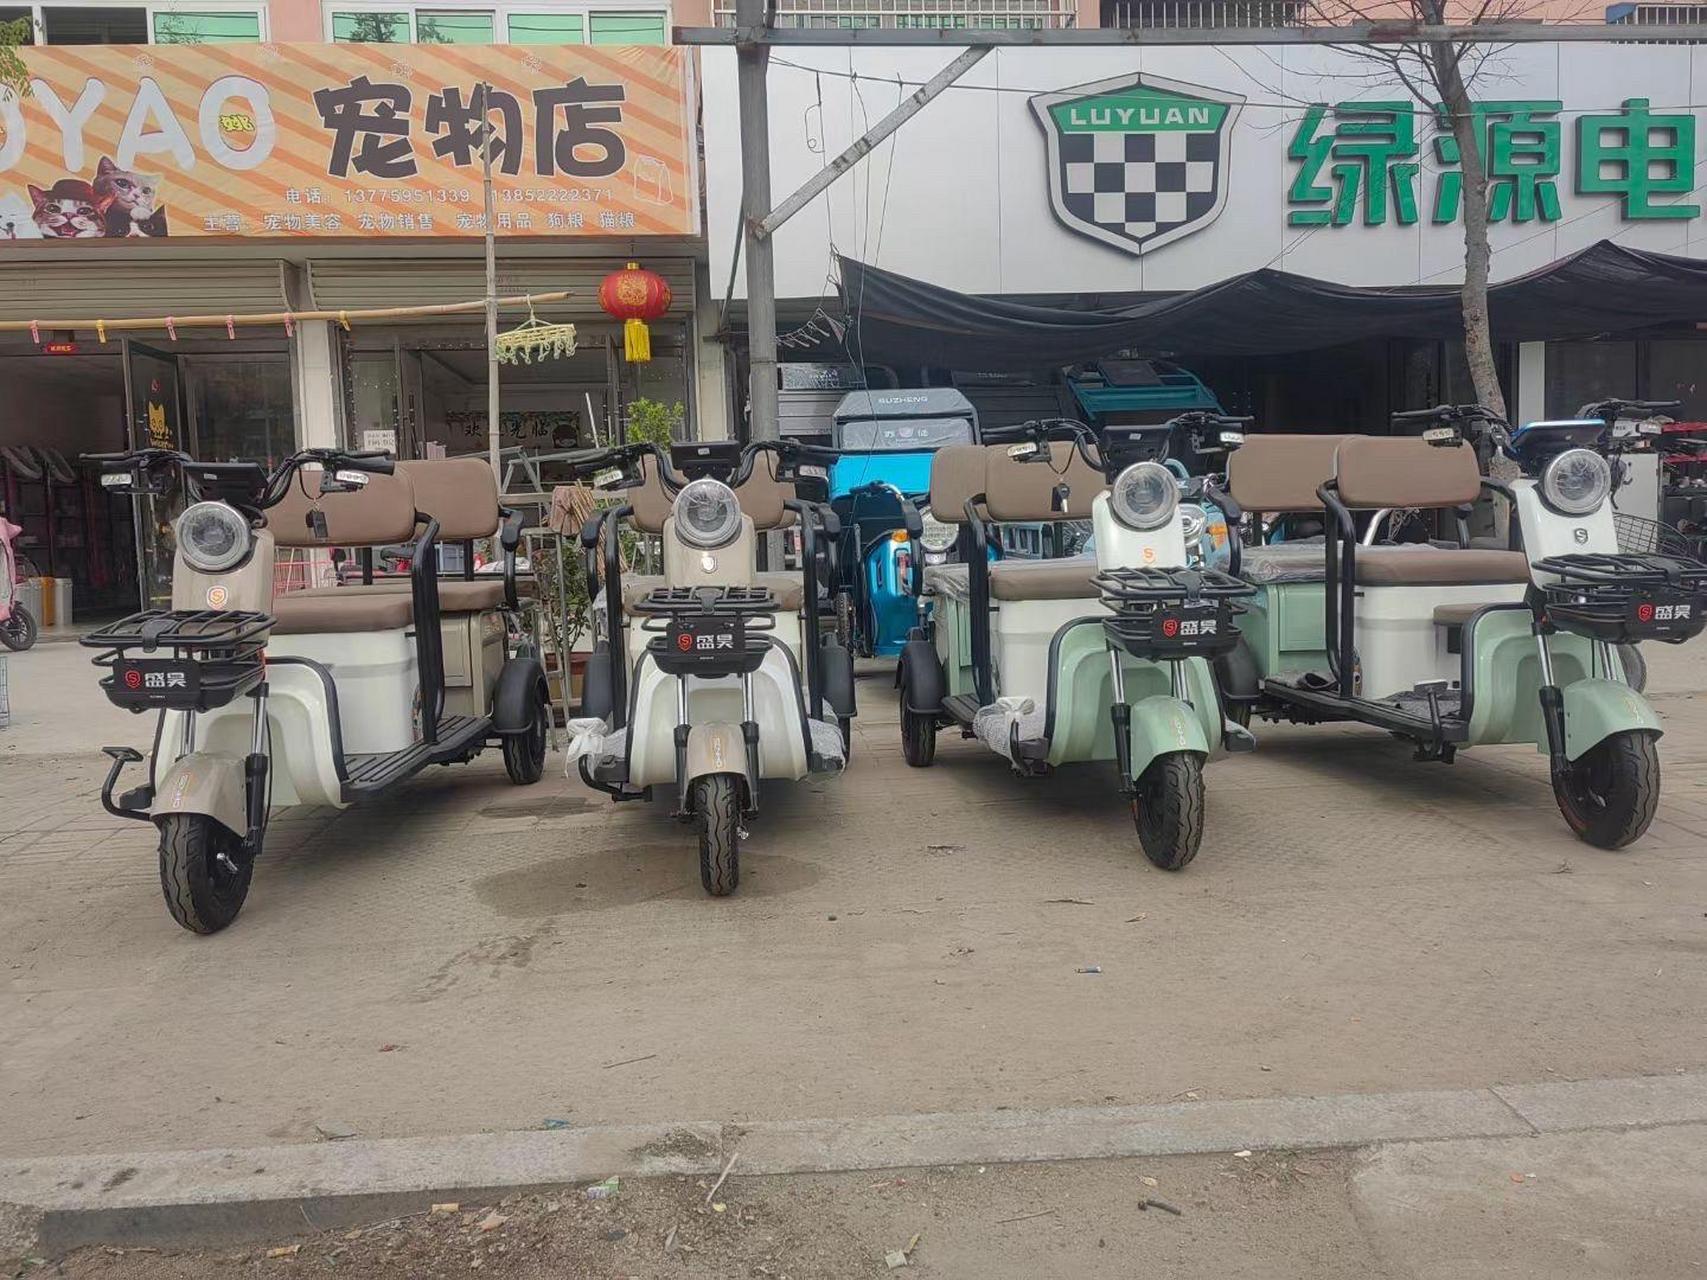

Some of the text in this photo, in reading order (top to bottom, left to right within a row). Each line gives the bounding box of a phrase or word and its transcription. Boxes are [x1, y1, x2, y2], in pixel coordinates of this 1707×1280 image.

[1070, 107, 1210, 126] LUYUAN
[312, 75, 626, 178] 宠物店
[1287, 97, 1701, 227] 绿源电
[262, 213, 342, 231] 宠物美容
[357, 212, 434, 231] 宠物销售
[1655, 605, 1691, 620] 盛昊
[1180, 620, 1217, 635] 盛昊
[696, 633, 734, 650] 盛昊
[145, 671, 187, 688] 盛昊
